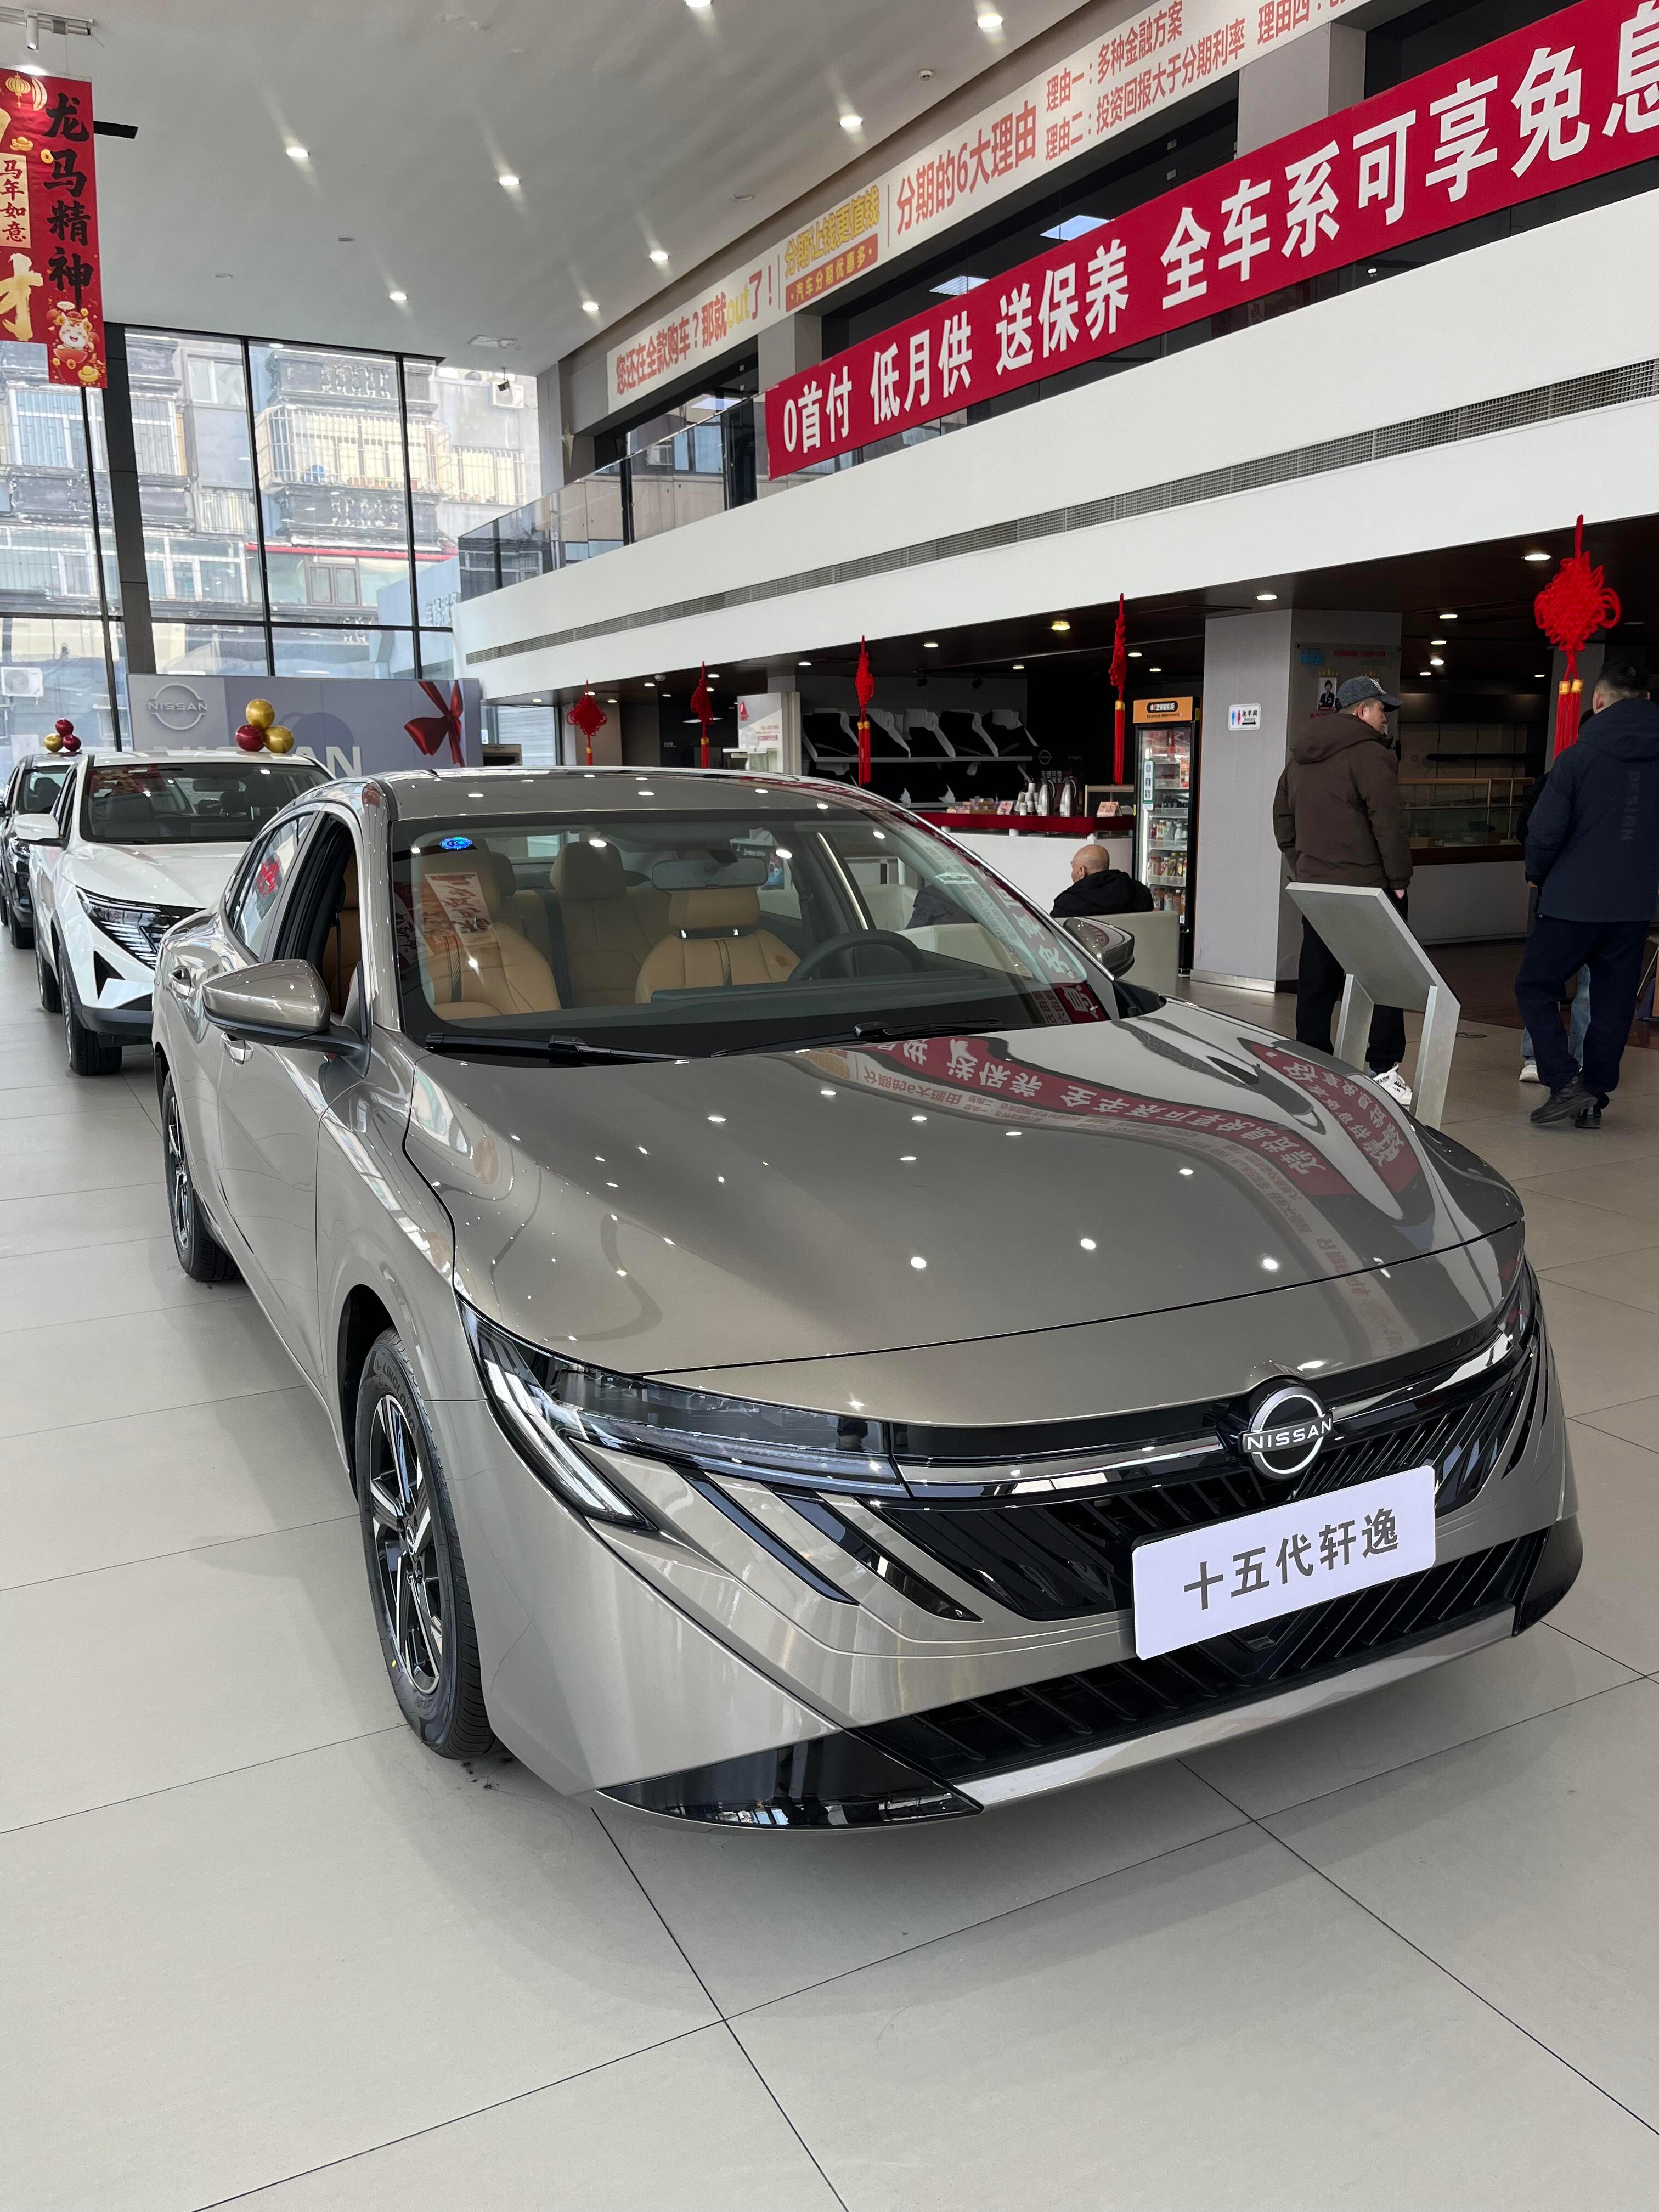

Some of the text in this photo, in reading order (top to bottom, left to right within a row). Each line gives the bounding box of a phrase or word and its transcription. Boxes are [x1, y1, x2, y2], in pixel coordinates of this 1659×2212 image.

[1046, 1, 1183, 112] 理由一：多种金融方案
[1046, 18, 1245, 161] 理由二：投资回报大于分期利率
[0, 159, 26, 242] 马年如意
[44, 93, 94, 311] 龙马精神
[897, 100, 1036, 235] 分期的6大理由
[783, 1, 1659, 453] 0首付 低月供 送保养 全车系可享免息
[616, 265, 772, 395] 您还在全款购车？那就out了！
[148, 701, 208, 712] NISSAN
[382, 1362, 415, 1436] LINGLONG
[1247, 1417, 1333, 1451] NISSAN
[1183, 1508, 1399, 1610] 十五代轩逸
